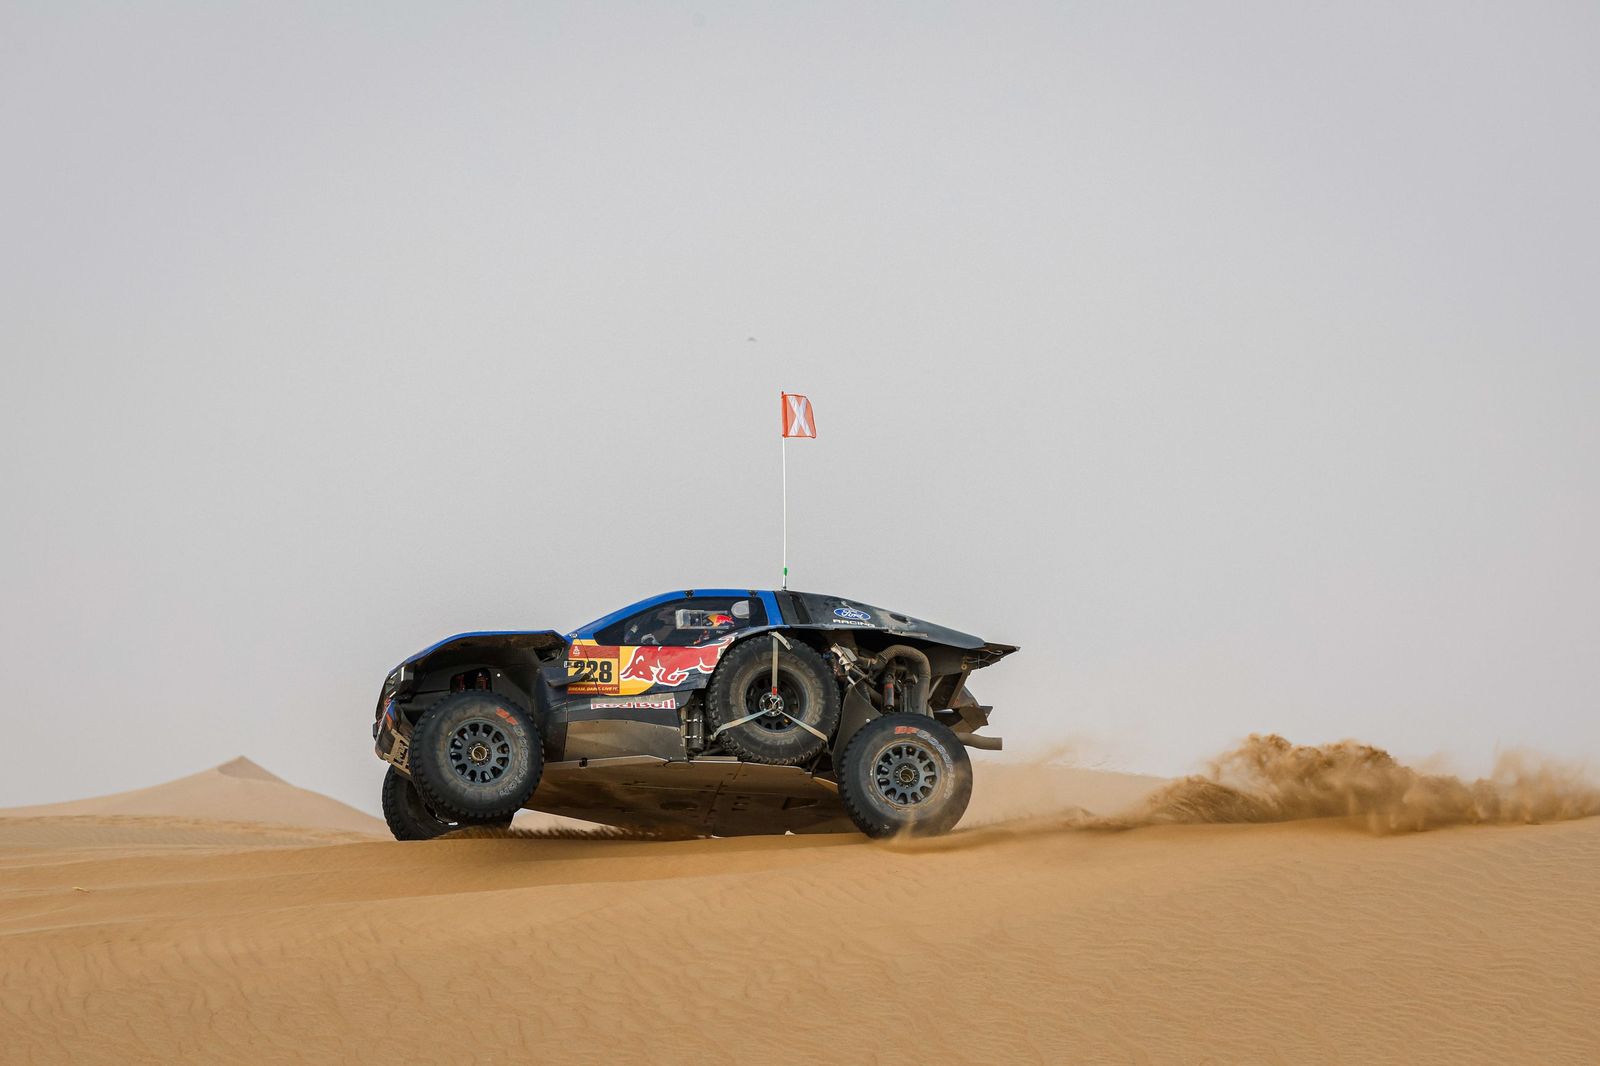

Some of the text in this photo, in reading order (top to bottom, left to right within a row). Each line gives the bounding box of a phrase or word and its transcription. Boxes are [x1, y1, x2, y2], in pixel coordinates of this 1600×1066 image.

[841, 609, 864, 618] Ford
[832, 619, 876, 627] RACING
[572, 660, 613, 683] 228
[636, 699, 674, 708] Bull
